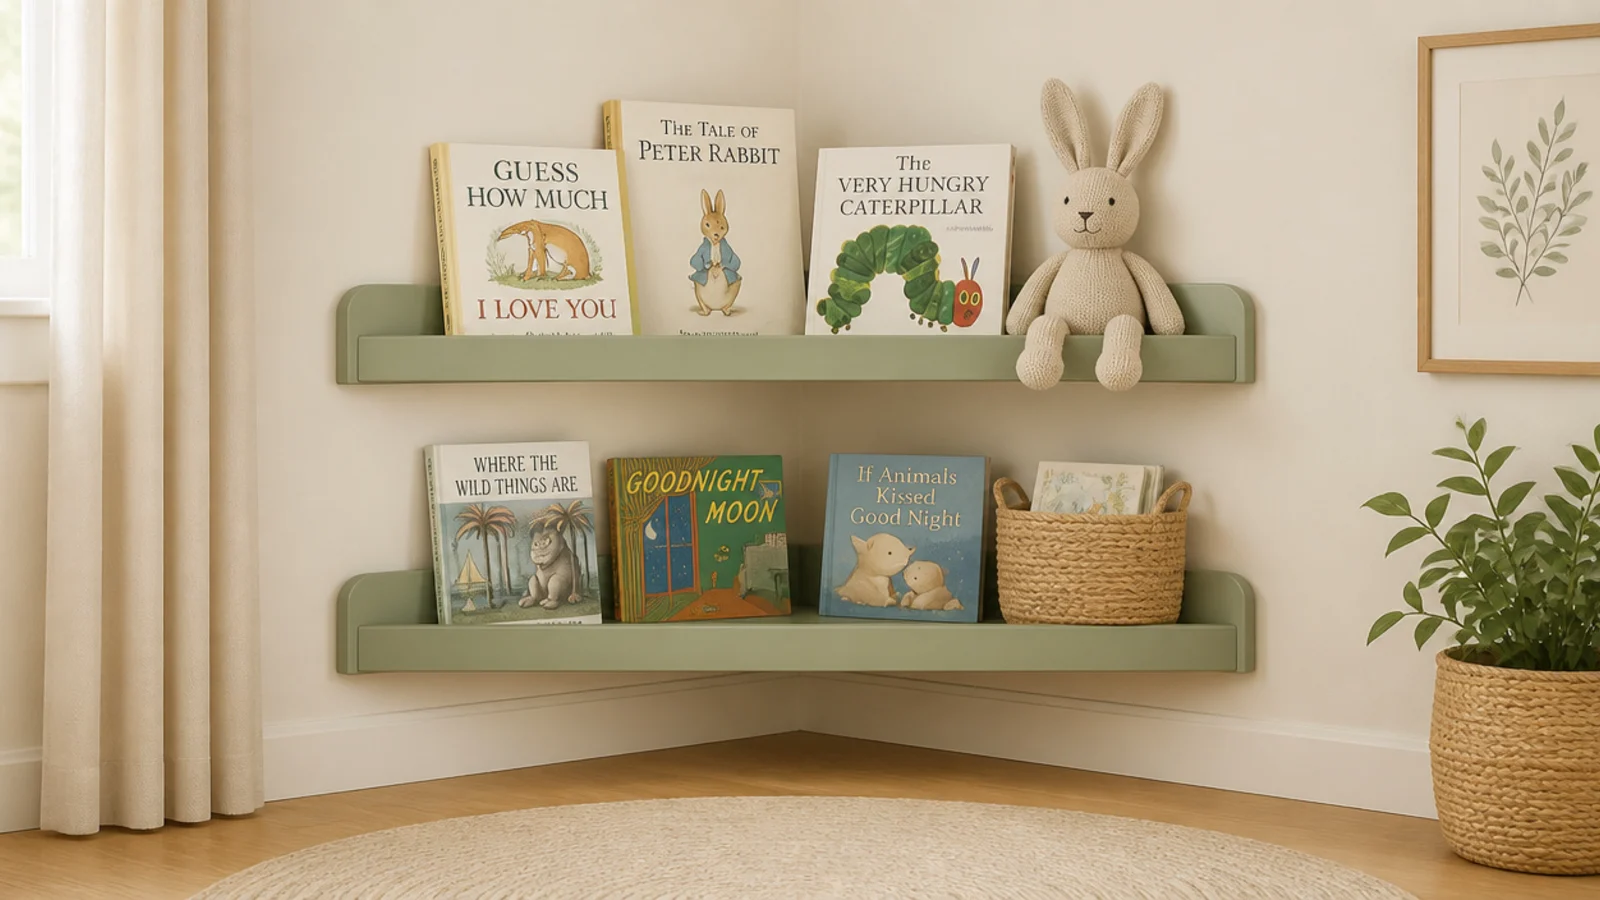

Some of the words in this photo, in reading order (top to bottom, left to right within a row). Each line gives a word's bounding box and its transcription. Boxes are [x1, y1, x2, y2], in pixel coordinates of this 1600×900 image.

[638, 139, 703, 162] PETER
[708, 143, 781, 165] RABBIT
[895, 155, 931, 171] The
[493, 159, 579, 183] GUESS
[838, 177, 892, 193] VERY
[898, 175, 989, 193] HUNGRY
[466, 186, 527, 208] HOW
[534, 188, 609, 211] MUCH
[840, 198, 984, 216] CATERPILLAR
[477, 298, 487, 320] I
[494, 298, 560, 320] LOVE
[565, 298, 617, 320] YOU
[473, 455, 526, 473] WHERE
[530, 454, 559, 472] THE
[455, 478, 492, 497] WILD
[494, 476, 548, 495] THINGS
[551, 475, 579, 493] ARE
[626, 469, 764, 495] GOODNIGHT
[856, 465, 874, 483] If
[878, 466, 957, 485] Animals
[876, 486, 936, 506] Kissed
[704, 499, 779, 524] MOON
[850, 507, 901, 526] Good
[907, 509, 961, 532] Night
